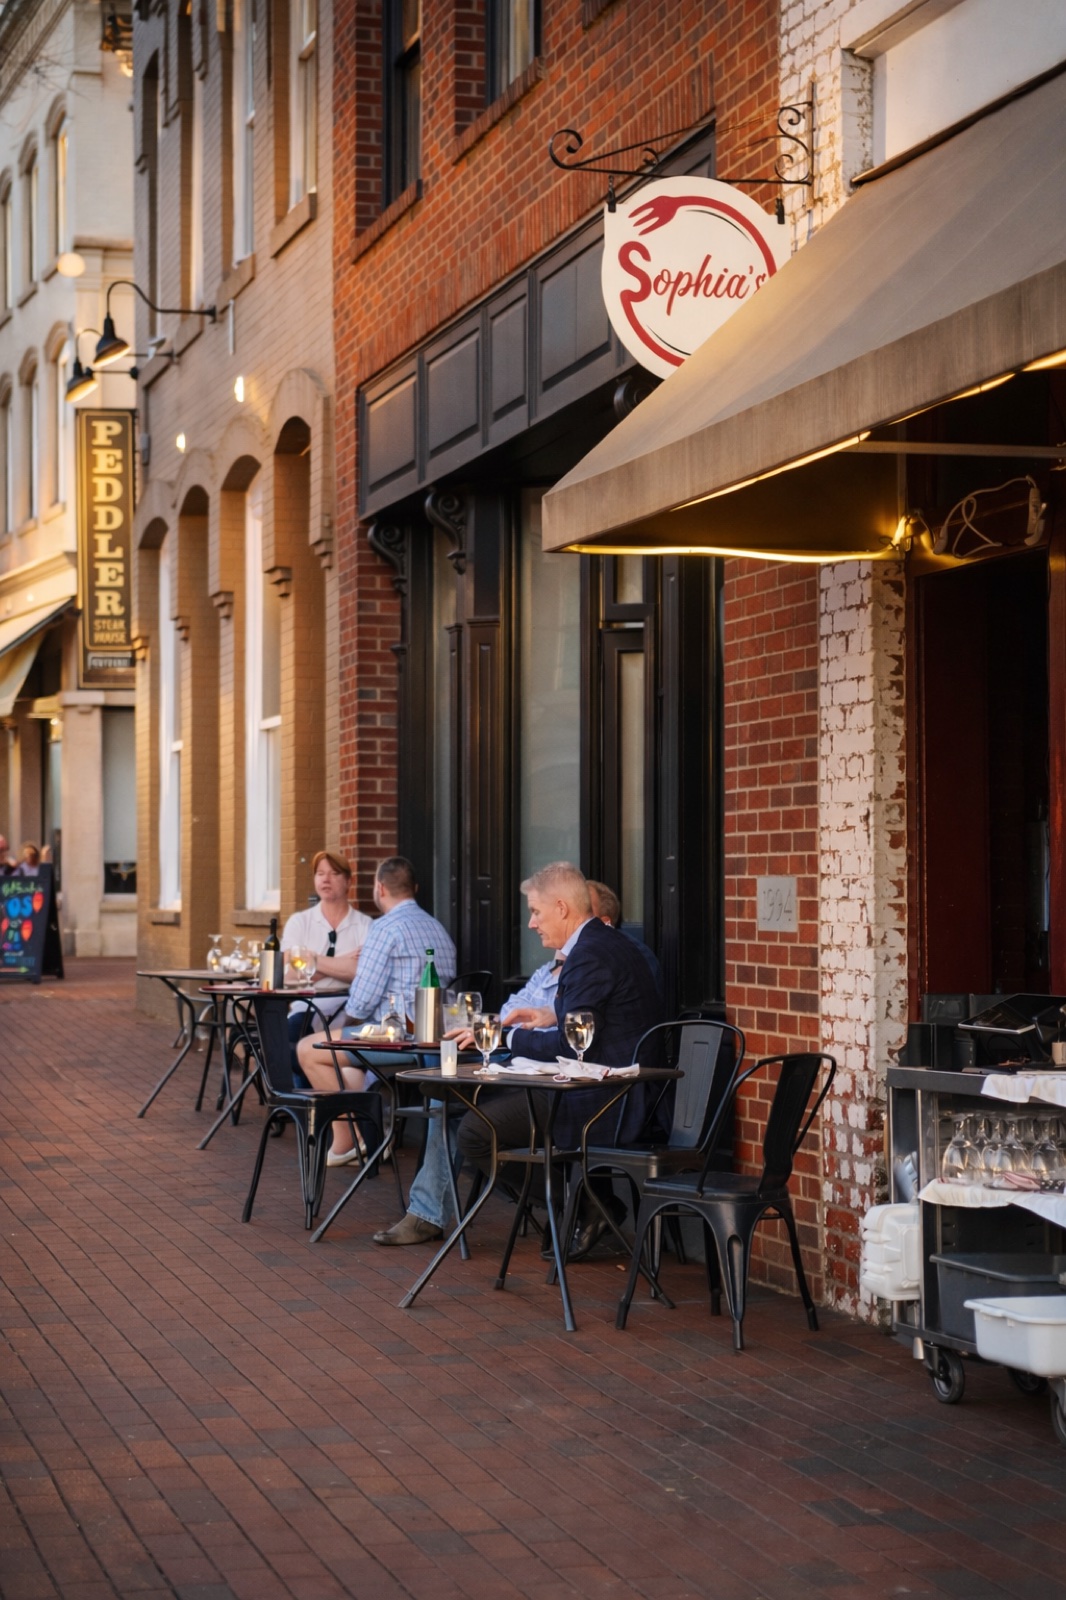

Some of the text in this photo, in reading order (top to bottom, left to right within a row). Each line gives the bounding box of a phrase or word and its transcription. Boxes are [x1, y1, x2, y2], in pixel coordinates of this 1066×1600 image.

[91, 420, 126, 616] PEDDLER
[93, 619, 126, 631] STEAK
[93, 632, 127, 644] HOUSE
[762, 888, 793, 922] 1994
